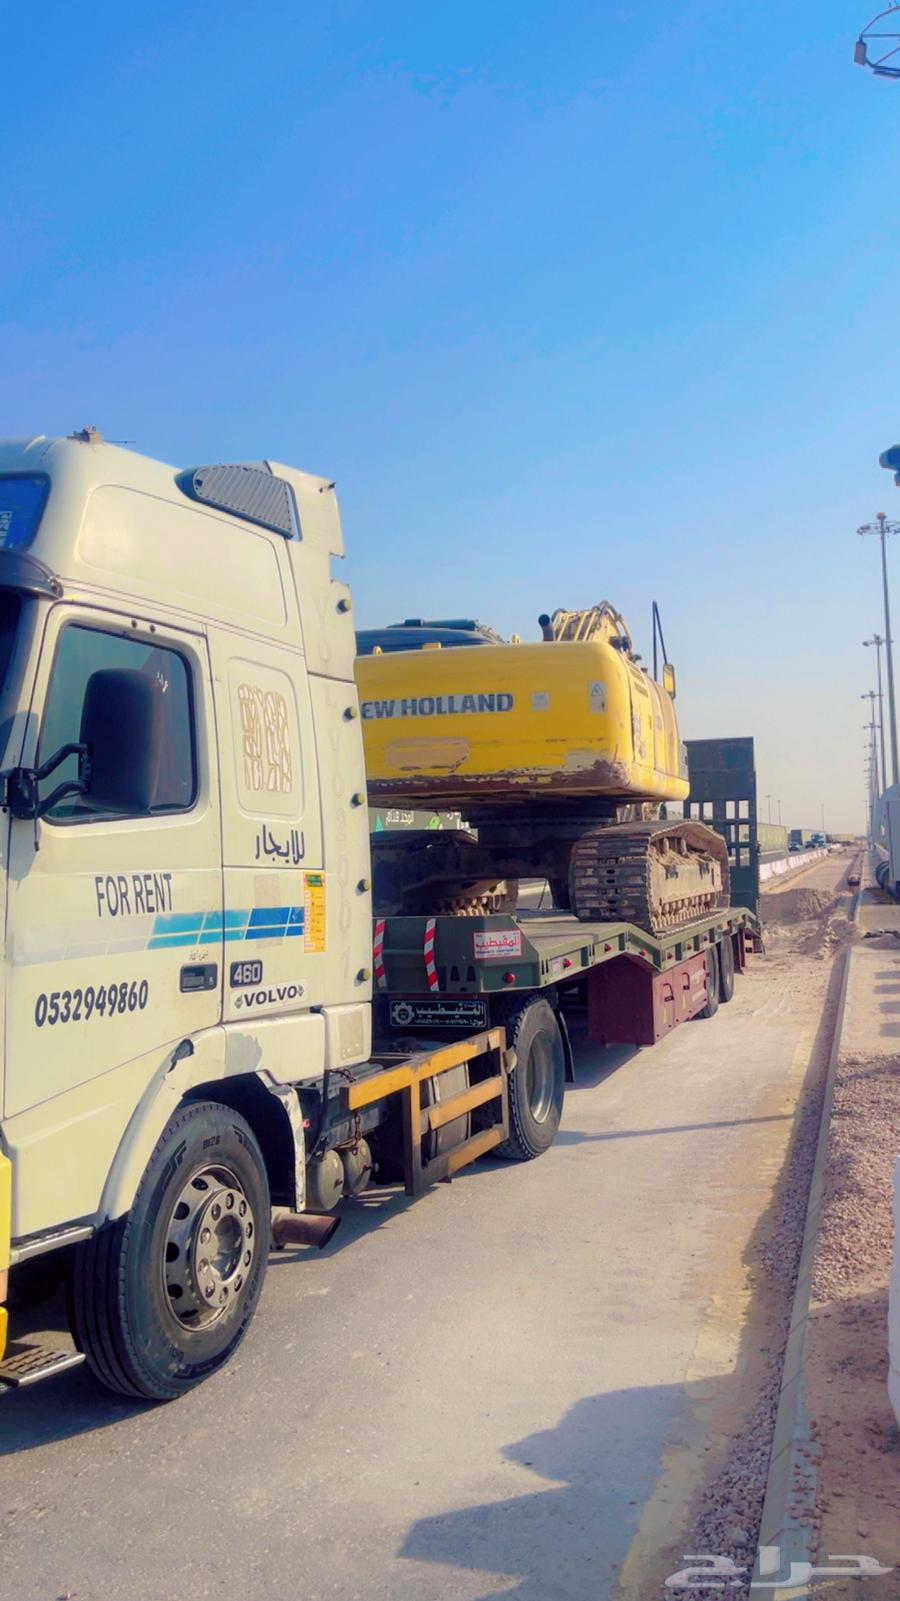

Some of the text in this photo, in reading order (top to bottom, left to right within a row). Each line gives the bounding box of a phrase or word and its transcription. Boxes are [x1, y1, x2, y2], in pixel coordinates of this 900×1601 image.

[361, 701, 398, 720] EW
[401, 693, 514, 717] HOLLAND
[95, 873, 173, 917] FOR RENT
[233, 963, 261, 984] 460
[34, 979, 149, 1028] 0532949860
[244, 985, 298, 1007] VOLVO
